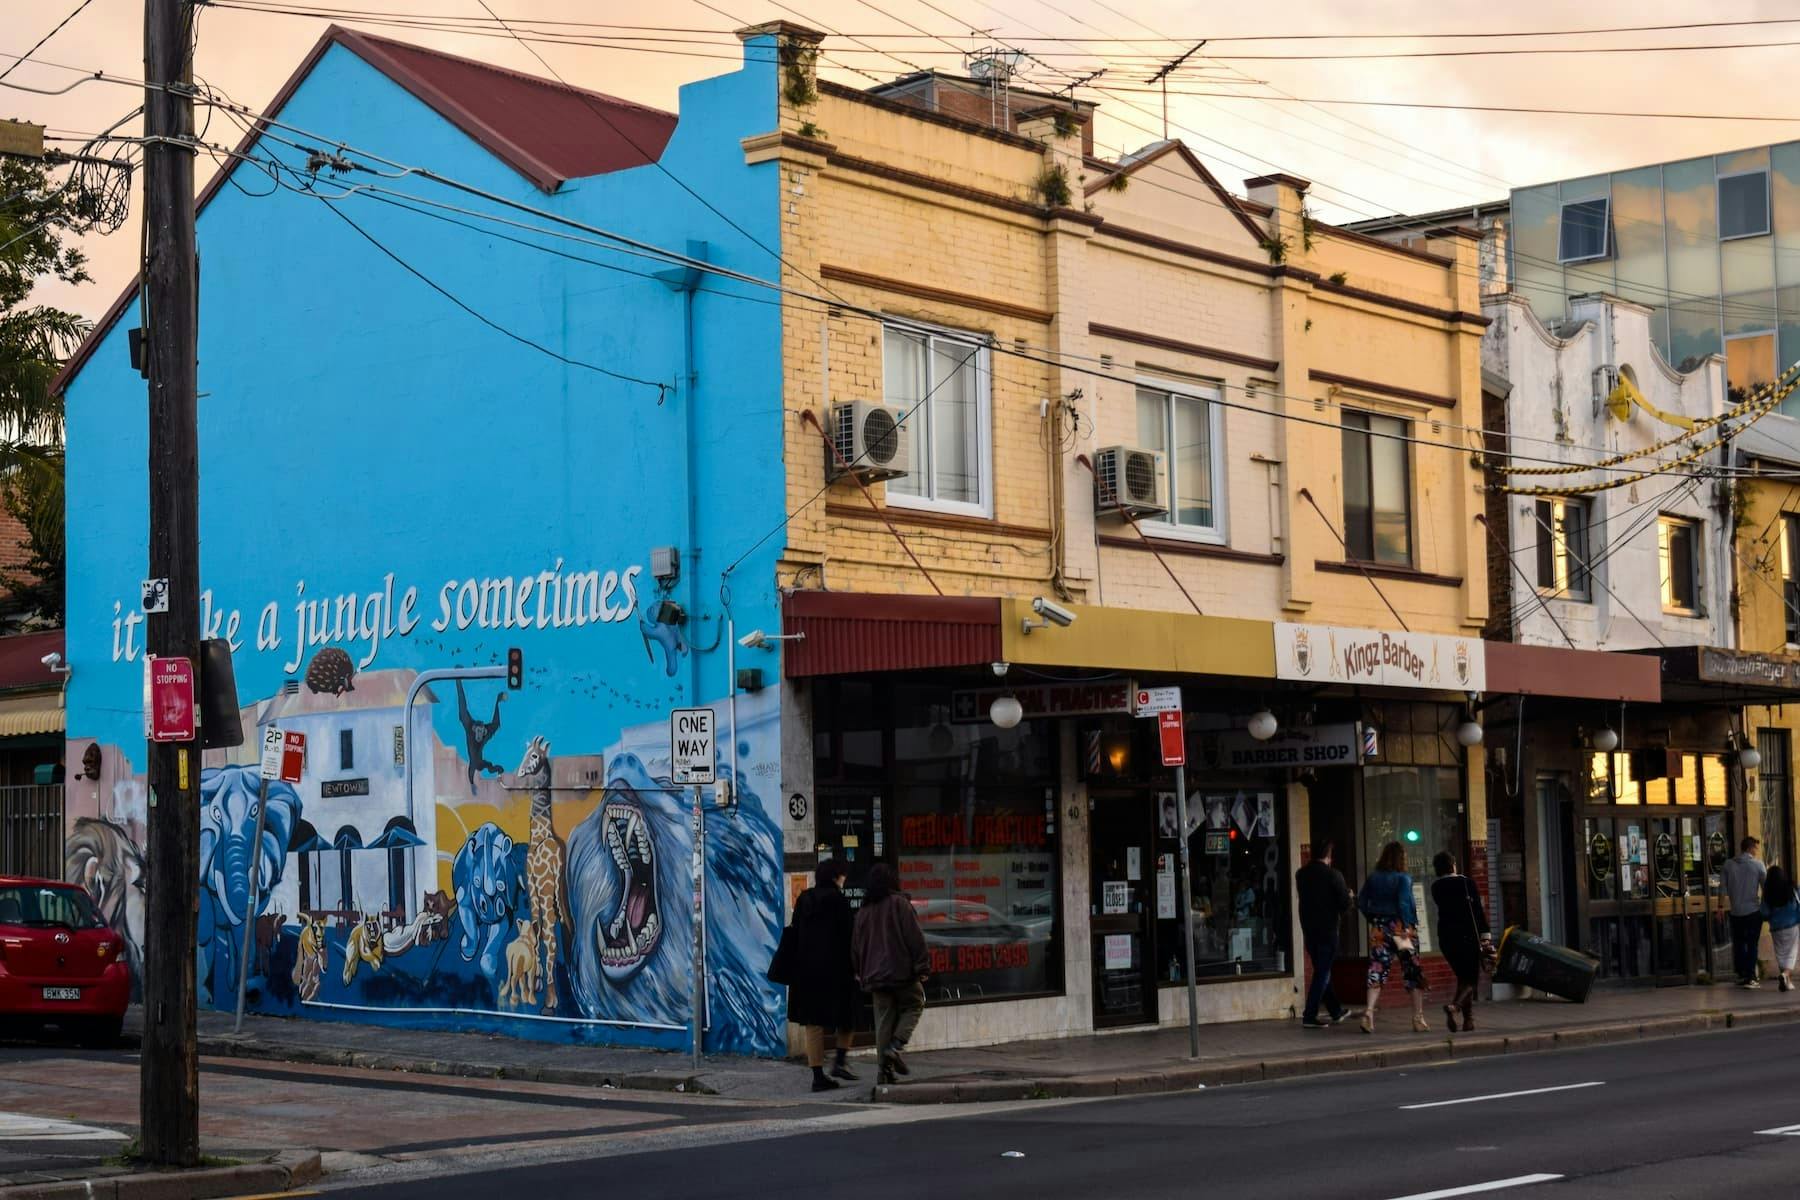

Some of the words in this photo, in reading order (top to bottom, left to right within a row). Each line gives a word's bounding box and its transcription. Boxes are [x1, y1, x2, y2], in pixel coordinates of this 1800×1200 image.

[256, 600, 281, 652] a
[284, 572, 421, 674] jungle
[431, 557, 643, 633] sometimes
[1344, 642, 1381, 681] Kingz
[1382, 633, 1425, 681] Barber
[166, 663, 178, 673] NO
[156, 674, 188, 685] STOPPING
[679, 716, 709, 734] ONE
[266, 730, 284, 744] 2P
[290, 735, 300, 745] NO
[678, 739, 709, 757] WAY
[1232, 749, 1298, 765] BARBER
[1304, 745, 1349, 761] SHOP
[790, 797, 807, 816] 38
[1068, 806, 1080, 820] 40
[902, 815, 970, 848] MEDICAL
[973, 814, 1048, 847] PRACTICE
